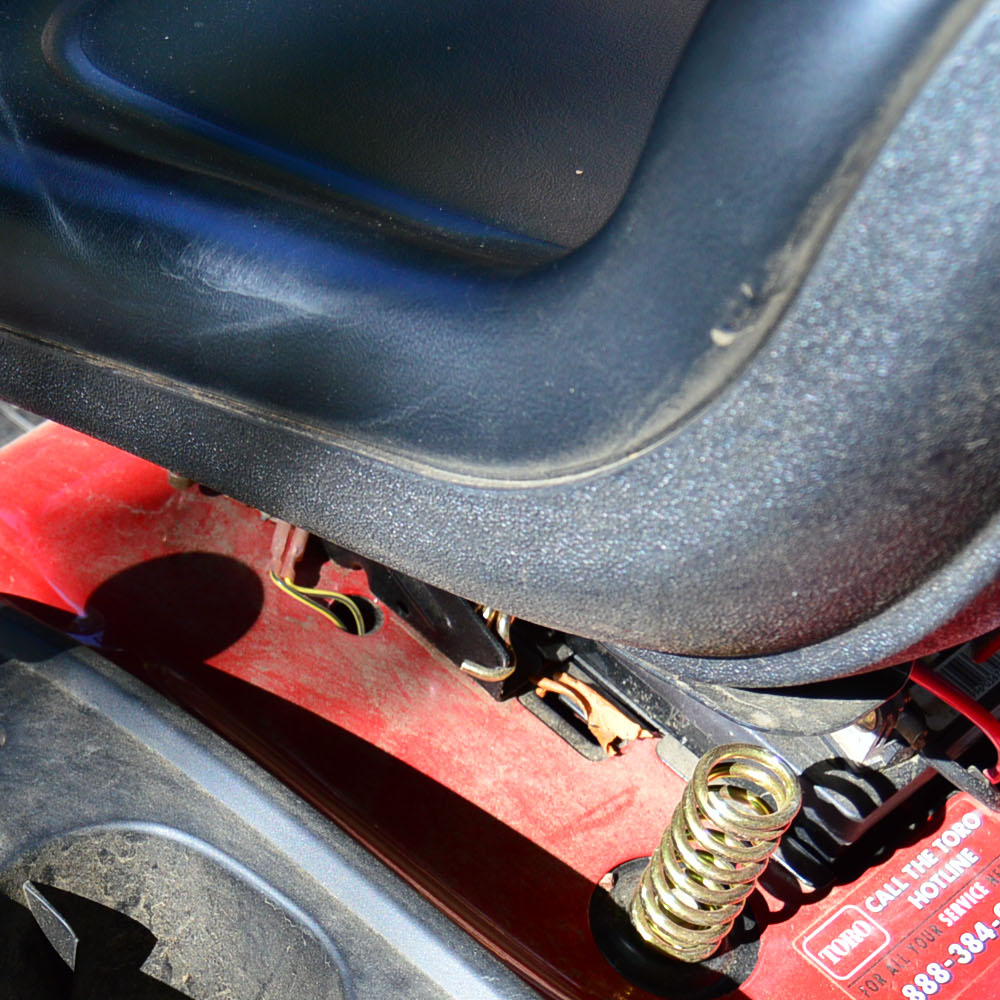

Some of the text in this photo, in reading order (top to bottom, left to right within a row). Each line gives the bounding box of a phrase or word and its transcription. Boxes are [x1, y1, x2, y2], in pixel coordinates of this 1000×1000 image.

[865, 811, 982, 913] CALL THE TORO
[907, 847, 980, 910] HOTLINE
[818, 920, 872, 965] TORO
[860, 973, 888, 998] FOR
[886, 953, 911, 976] ALL
[905, 924, 944, 955] YOUR
[938, 881, 990, 927] SERVICE
